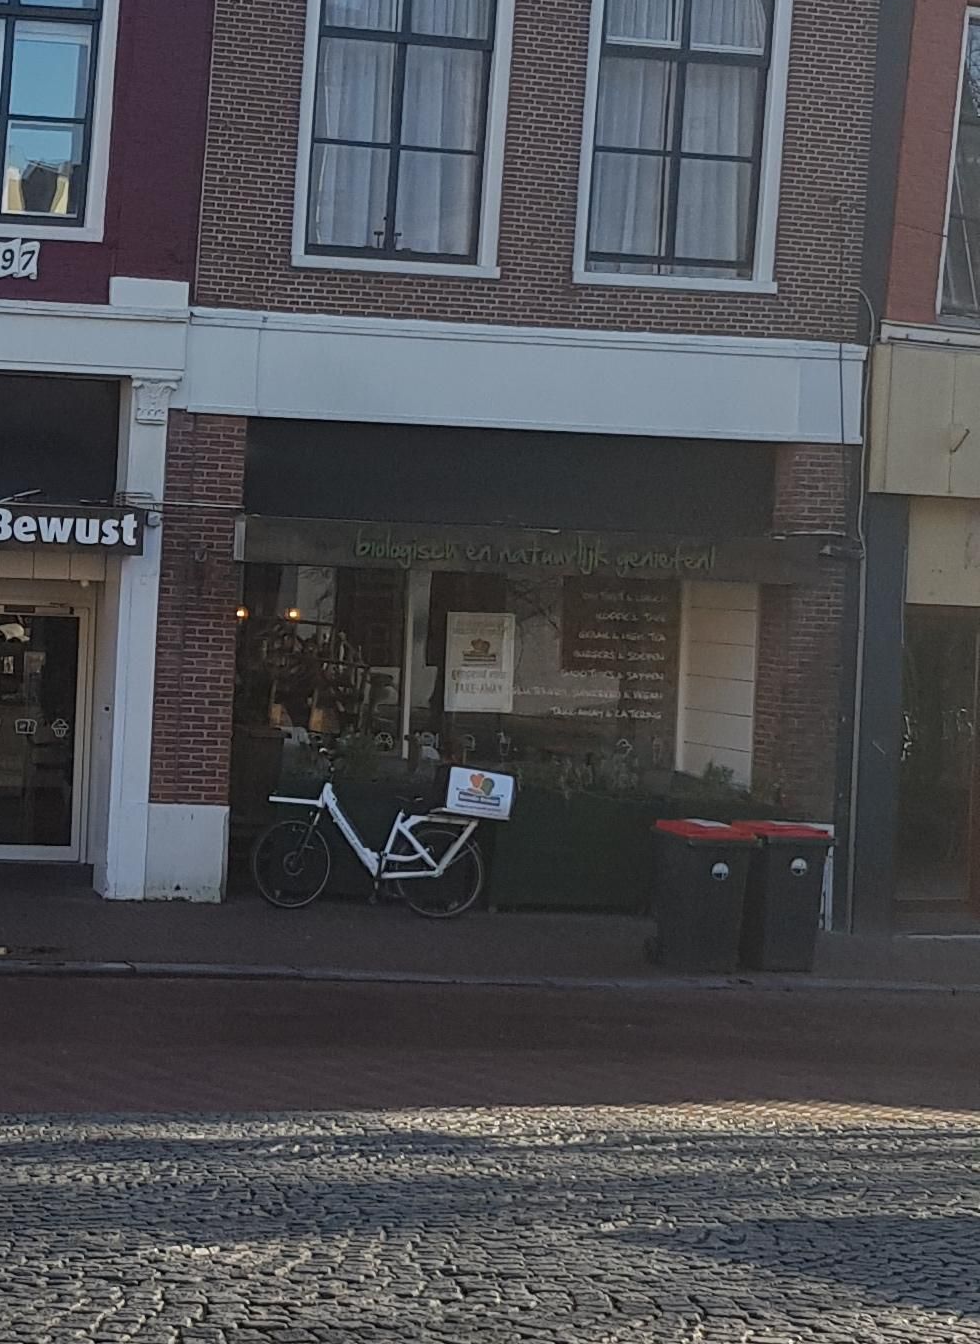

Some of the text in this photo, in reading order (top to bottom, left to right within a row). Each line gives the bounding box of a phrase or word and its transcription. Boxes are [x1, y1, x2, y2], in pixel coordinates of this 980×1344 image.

[355, 528, 458, 569] biologisch
[468, 545, 493, 562] en
[499, 536, 610, 575] natuurlijk
